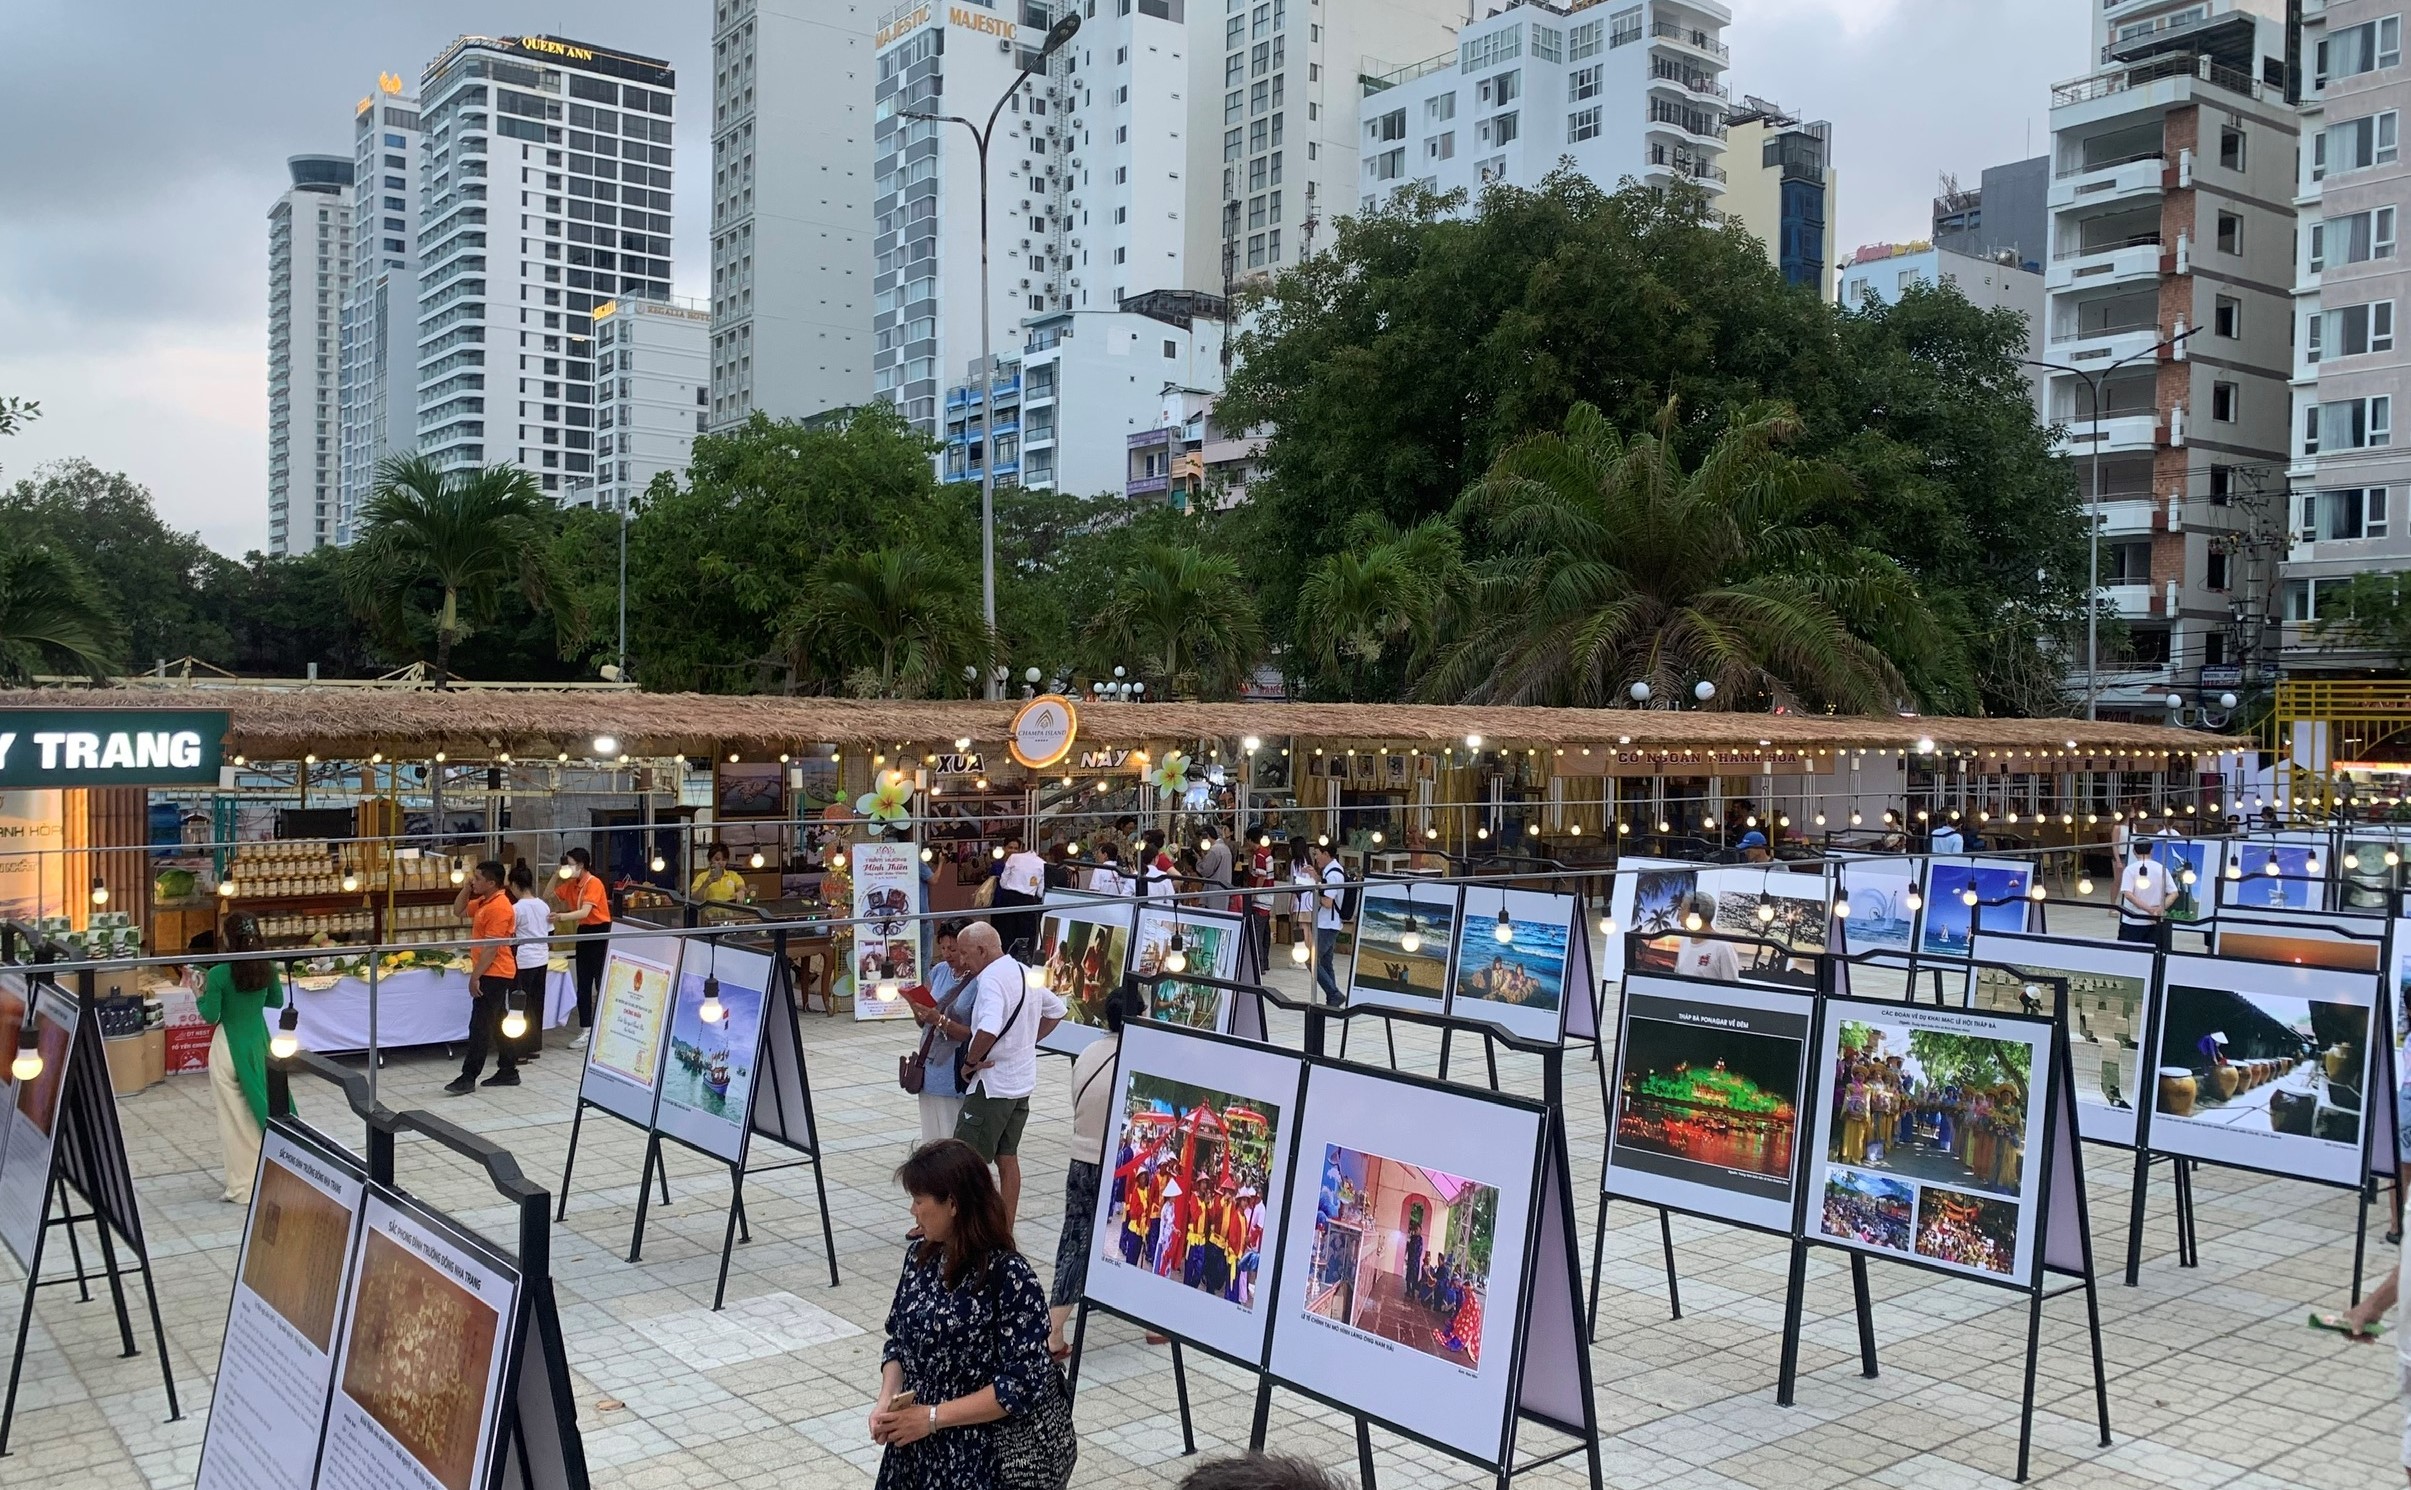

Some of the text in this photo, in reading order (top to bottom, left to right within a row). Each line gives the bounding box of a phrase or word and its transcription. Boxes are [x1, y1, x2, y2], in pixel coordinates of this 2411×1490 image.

[875, 4, 931, 50] MAJESTIC
[949, 6, 1017, 40] MAJESTIC
[522, 37, 592, 61] QUEEN ANN
[34, 732, 201, 769] TRANG
[1079, 750, 1130, 769] NAY
[1700, 1016, 1728, 1026] PONAGAR
[397, 1227, 412, 1244] PHONG
[454, 1264, 464, 1280] NHA
[464, 1271, 482, 1291] TRANG
